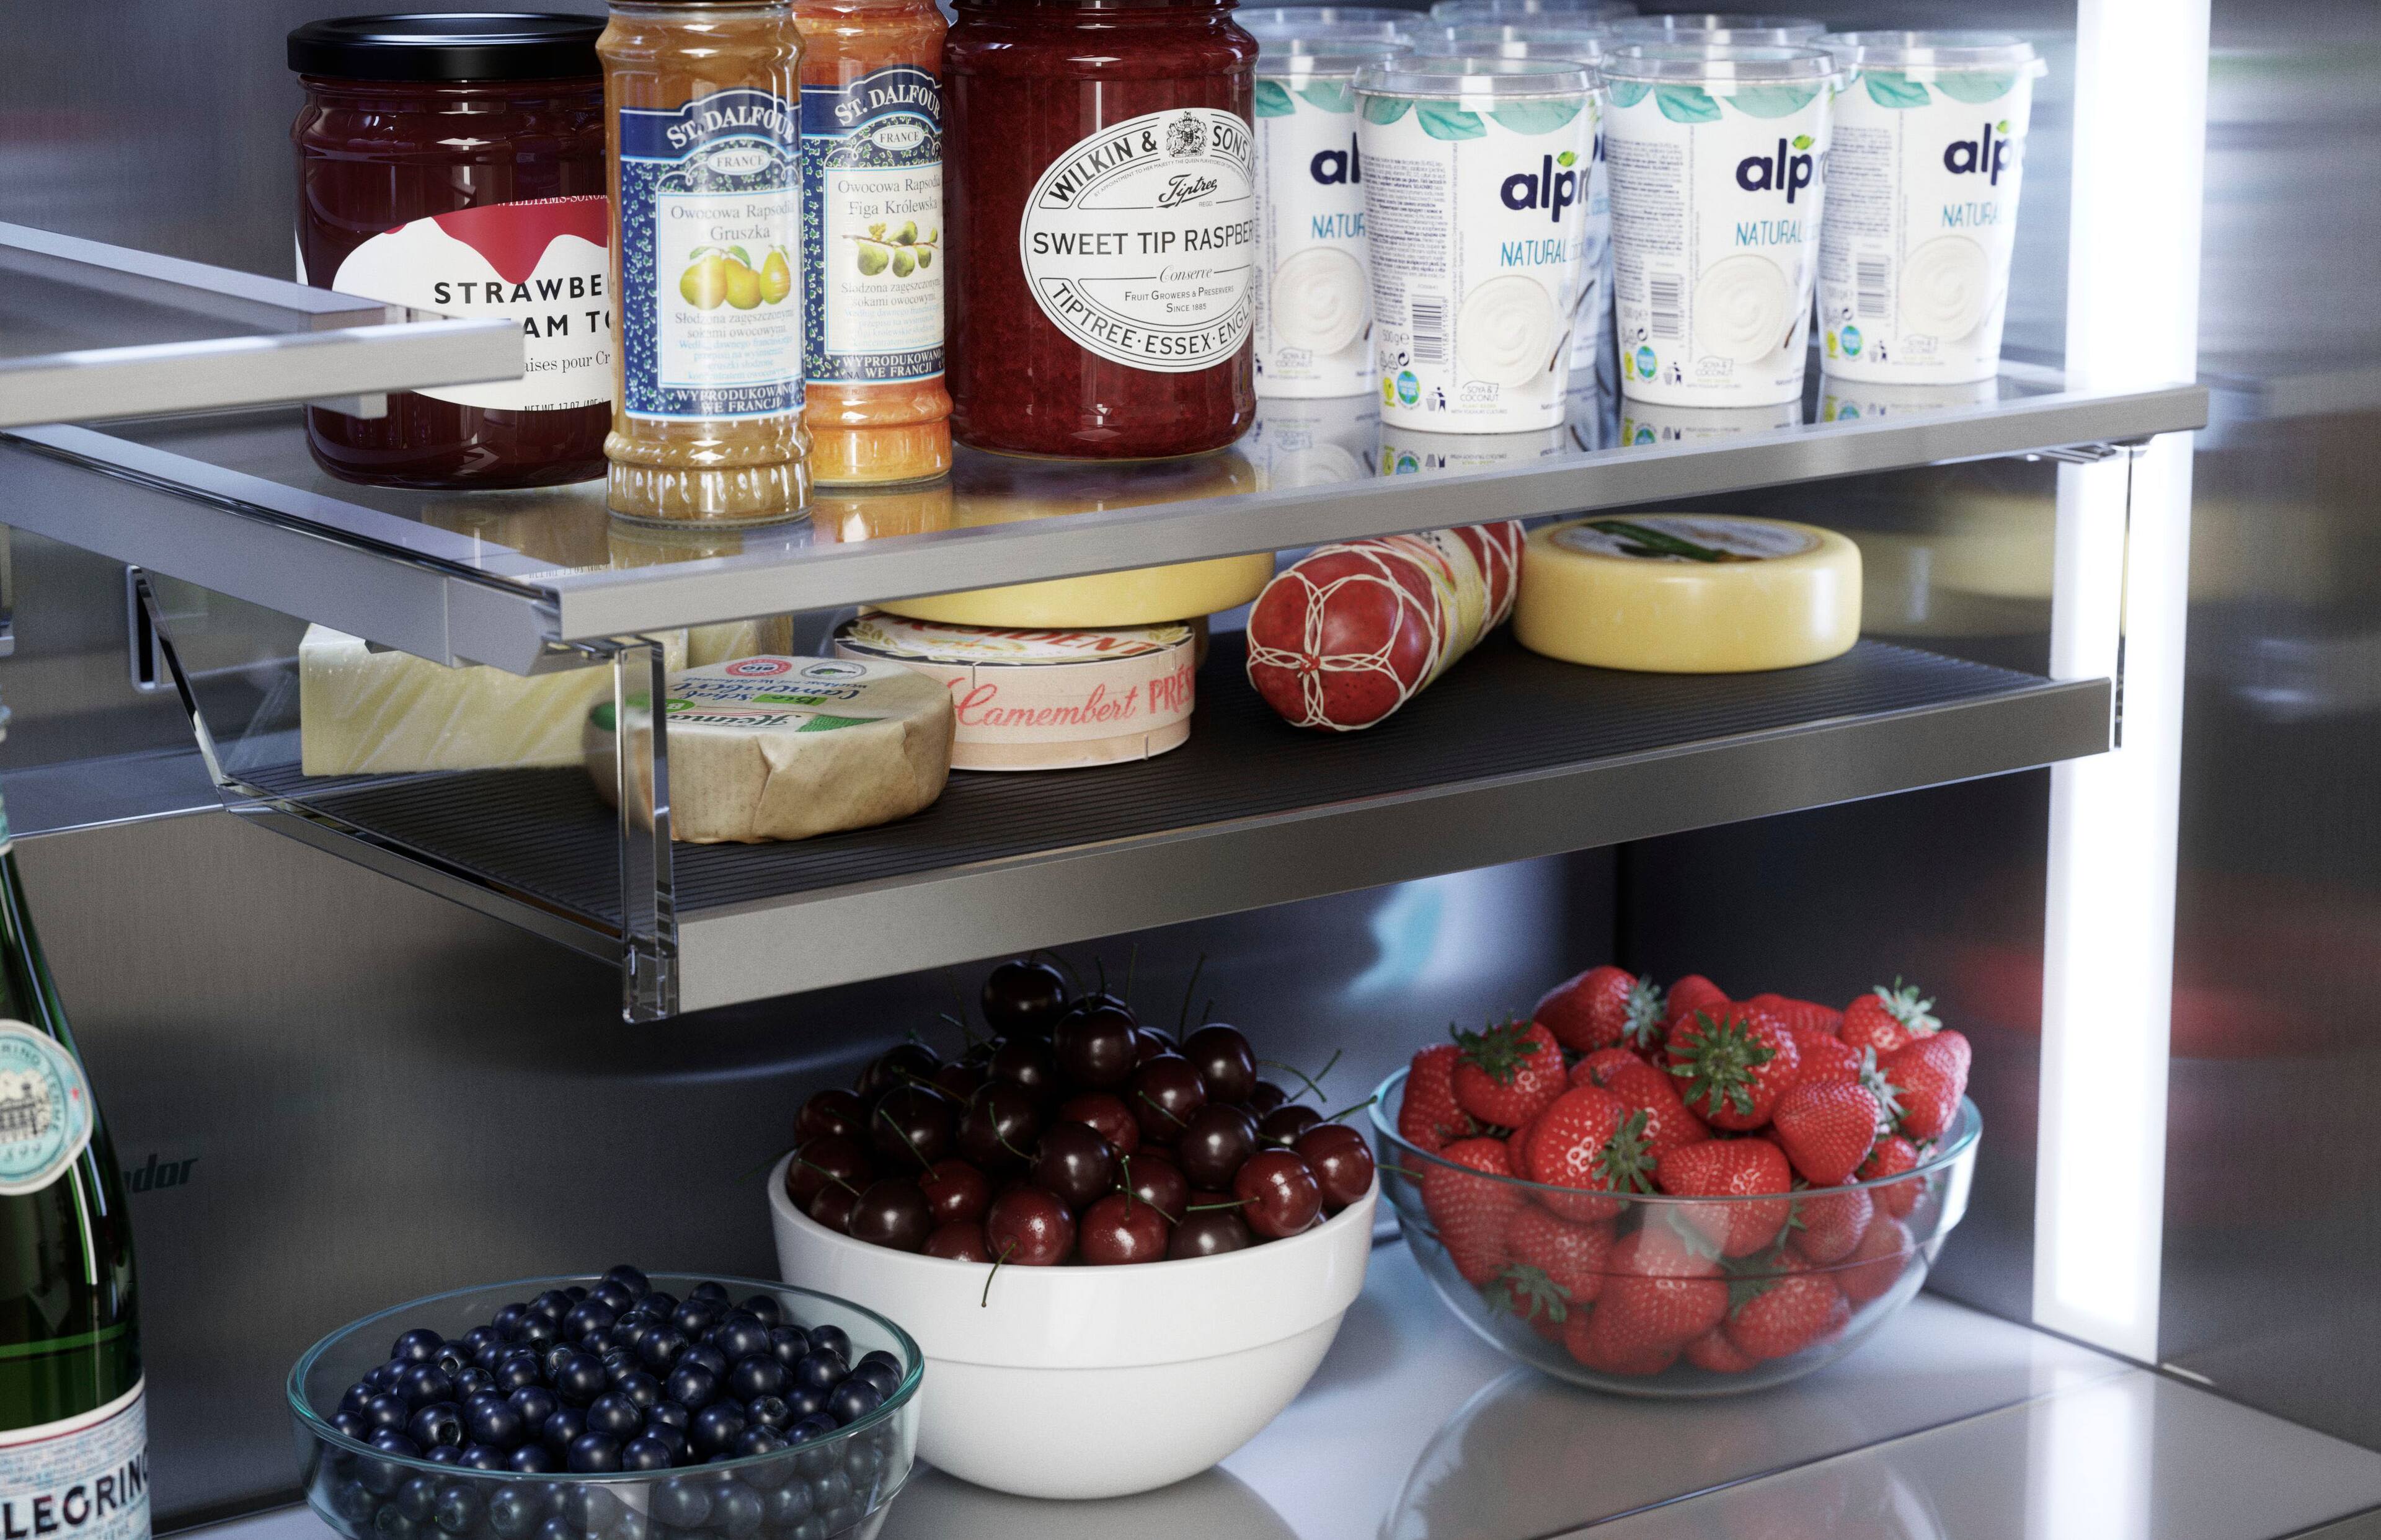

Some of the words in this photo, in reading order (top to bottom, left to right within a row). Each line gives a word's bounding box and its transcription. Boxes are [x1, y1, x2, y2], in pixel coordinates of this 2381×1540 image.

[835, 99, 867, 126] ST.
[868, 84, 941, 120] DALFOUR
[667, 118, 703, 149] ST.
[704, 105, 795, 139] DALFOUR
[880, 131, 920, 143] FRANCE
[717, 156, 764, 167] FRANCE
[1049, 137, 1133, 203] WILKIN
[1142, 131, 1158, 153] &
[1212, 125, 1248, 162] SONS
[838, 180, 900, 193] Owocowa
[1157, 174, 1217, 208] Tiptree
[671, 205, 740, 219] Owocowa
[849, 201, 878, 218] Figa
[885, 196, 938, 215] Królewska
[710, 224, 770, 241] Gruszka
[1033, 232, 1128, 255] SWEET
[1137, 231, 1176, 254] TIP
[1501, 239, 1567, 267] NATURAL
[1160, 265, 1213, 283] Conserve
[434, 272, 610, 304] STRAWBE
[1125, 291, 1150, 301] FRUIT
[1151, 290, 1190, 301] GROWERS
[1199, 285, 1235, 296] PRESERVERS
[1166, 303, 1190, 312] SINCE
[1192, 303, 1207, 311] 1885
[562, 356, 593, 373] pour
[843, 348, 941, 367] WYPRODUKOWANO
[866, 367, 886, 378] WE
[890, 362, 932, 377] FRANCJI
[676, 383, 795, 402] WYPRODUKOWANO
[1460, 393, 1499, 402] COCONUT
[701, 400, 724, 412] WE
[728, 397, 783, 412] FRANCJI
[672, 681, 861, 700] Camembert
[947, 677, 1138, 727] Camembert
